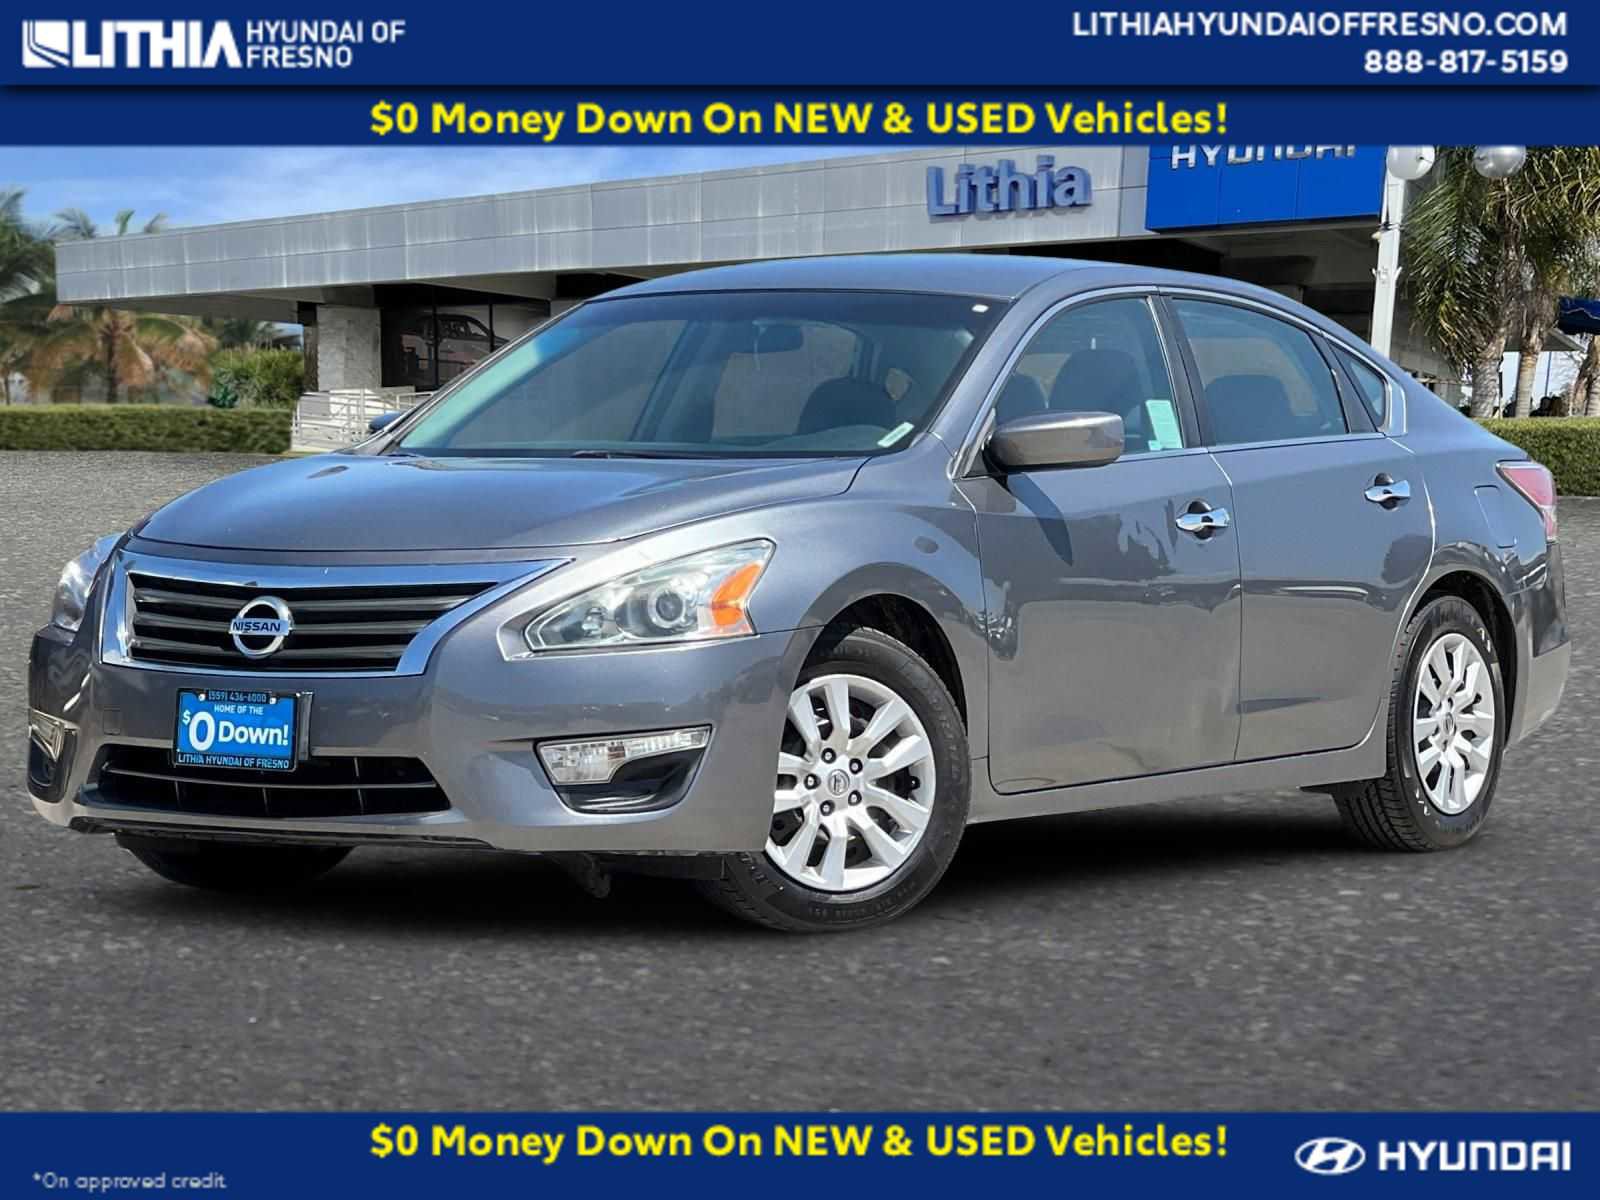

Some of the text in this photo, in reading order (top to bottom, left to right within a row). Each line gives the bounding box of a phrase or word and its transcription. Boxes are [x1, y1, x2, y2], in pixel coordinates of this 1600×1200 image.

[926, 154, 1092, 216] Lithia
[232, 621, 281, 632] NISSAN
[214, 704, 265, 716] HOME OF THE
[218, 720, 289, 746] Down!
[178, 754, 290, 769] LITHIA HYUNDAI OF FRESNO
